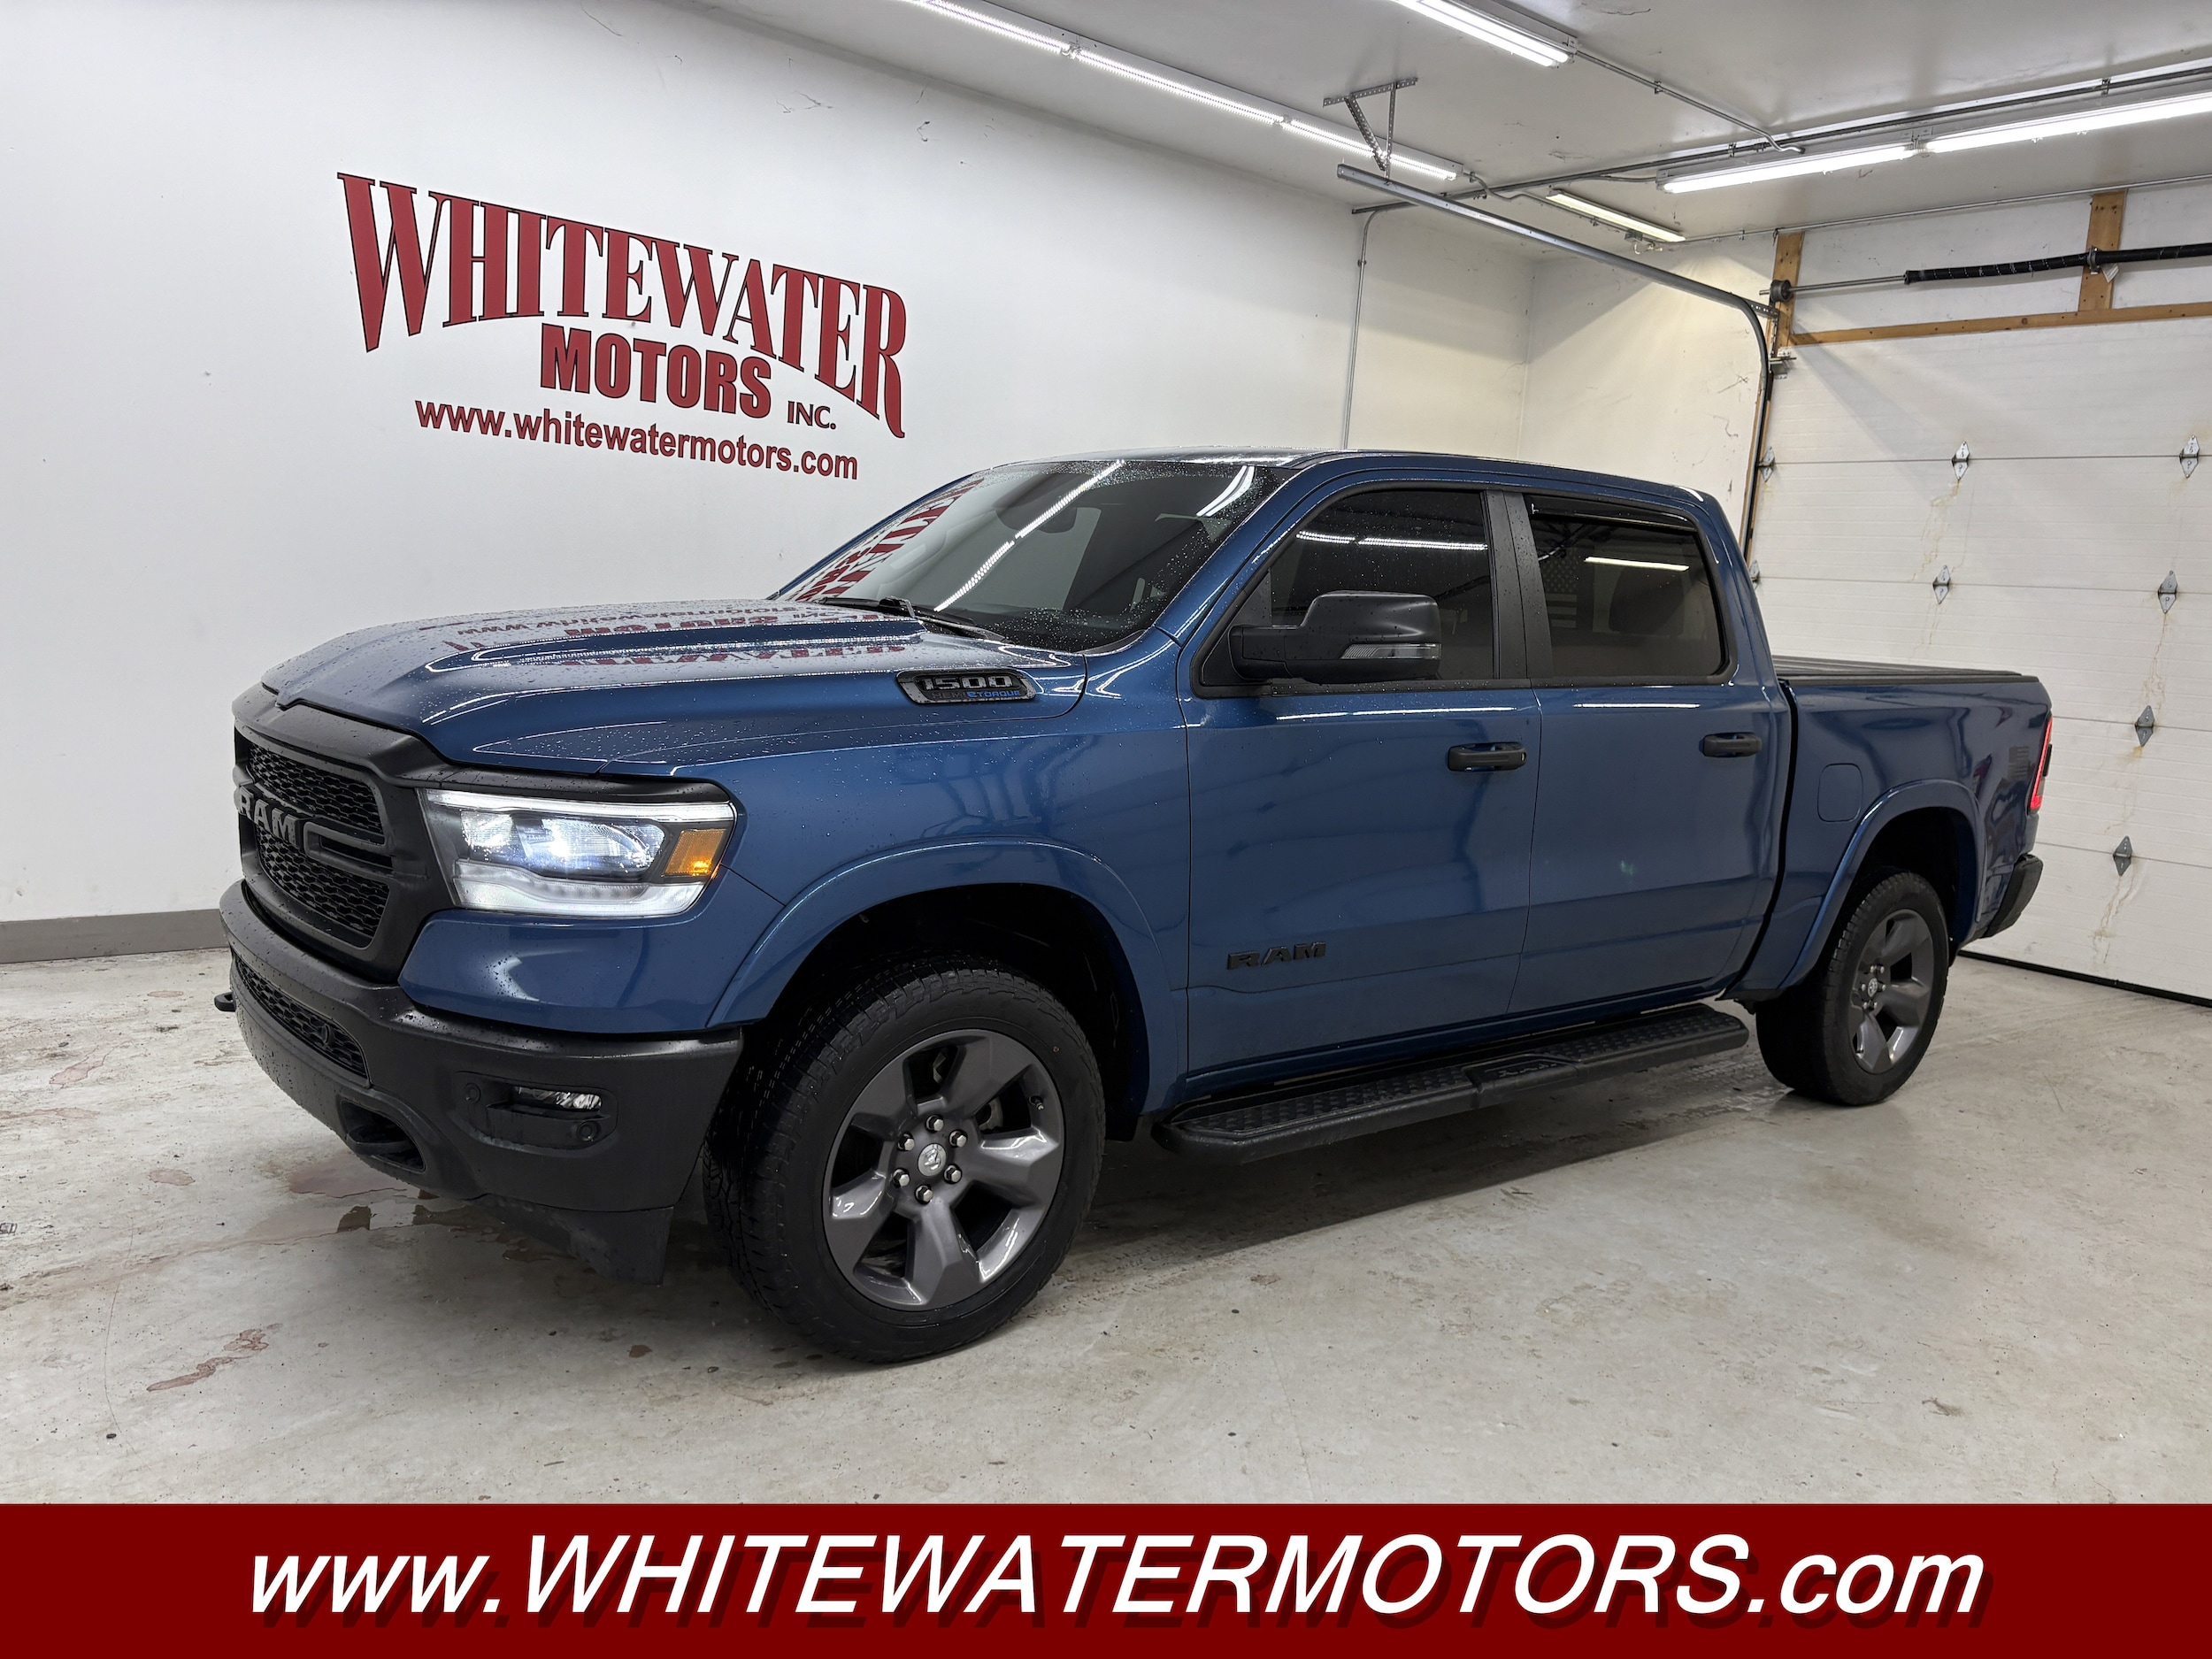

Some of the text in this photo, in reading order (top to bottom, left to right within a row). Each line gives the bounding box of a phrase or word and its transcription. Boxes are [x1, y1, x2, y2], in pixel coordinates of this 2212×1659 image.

[337, 172, 906, 437] WHITEWATER
[540, 323, 836, 429] MOTORS INC.
[415, 400, 858, 480] www.whitewatermotors.com
[923, 675, 1014, 690] 1500
[234, 785, 298, 849] RAM
[1226, 941, 1326, 970] RAM
